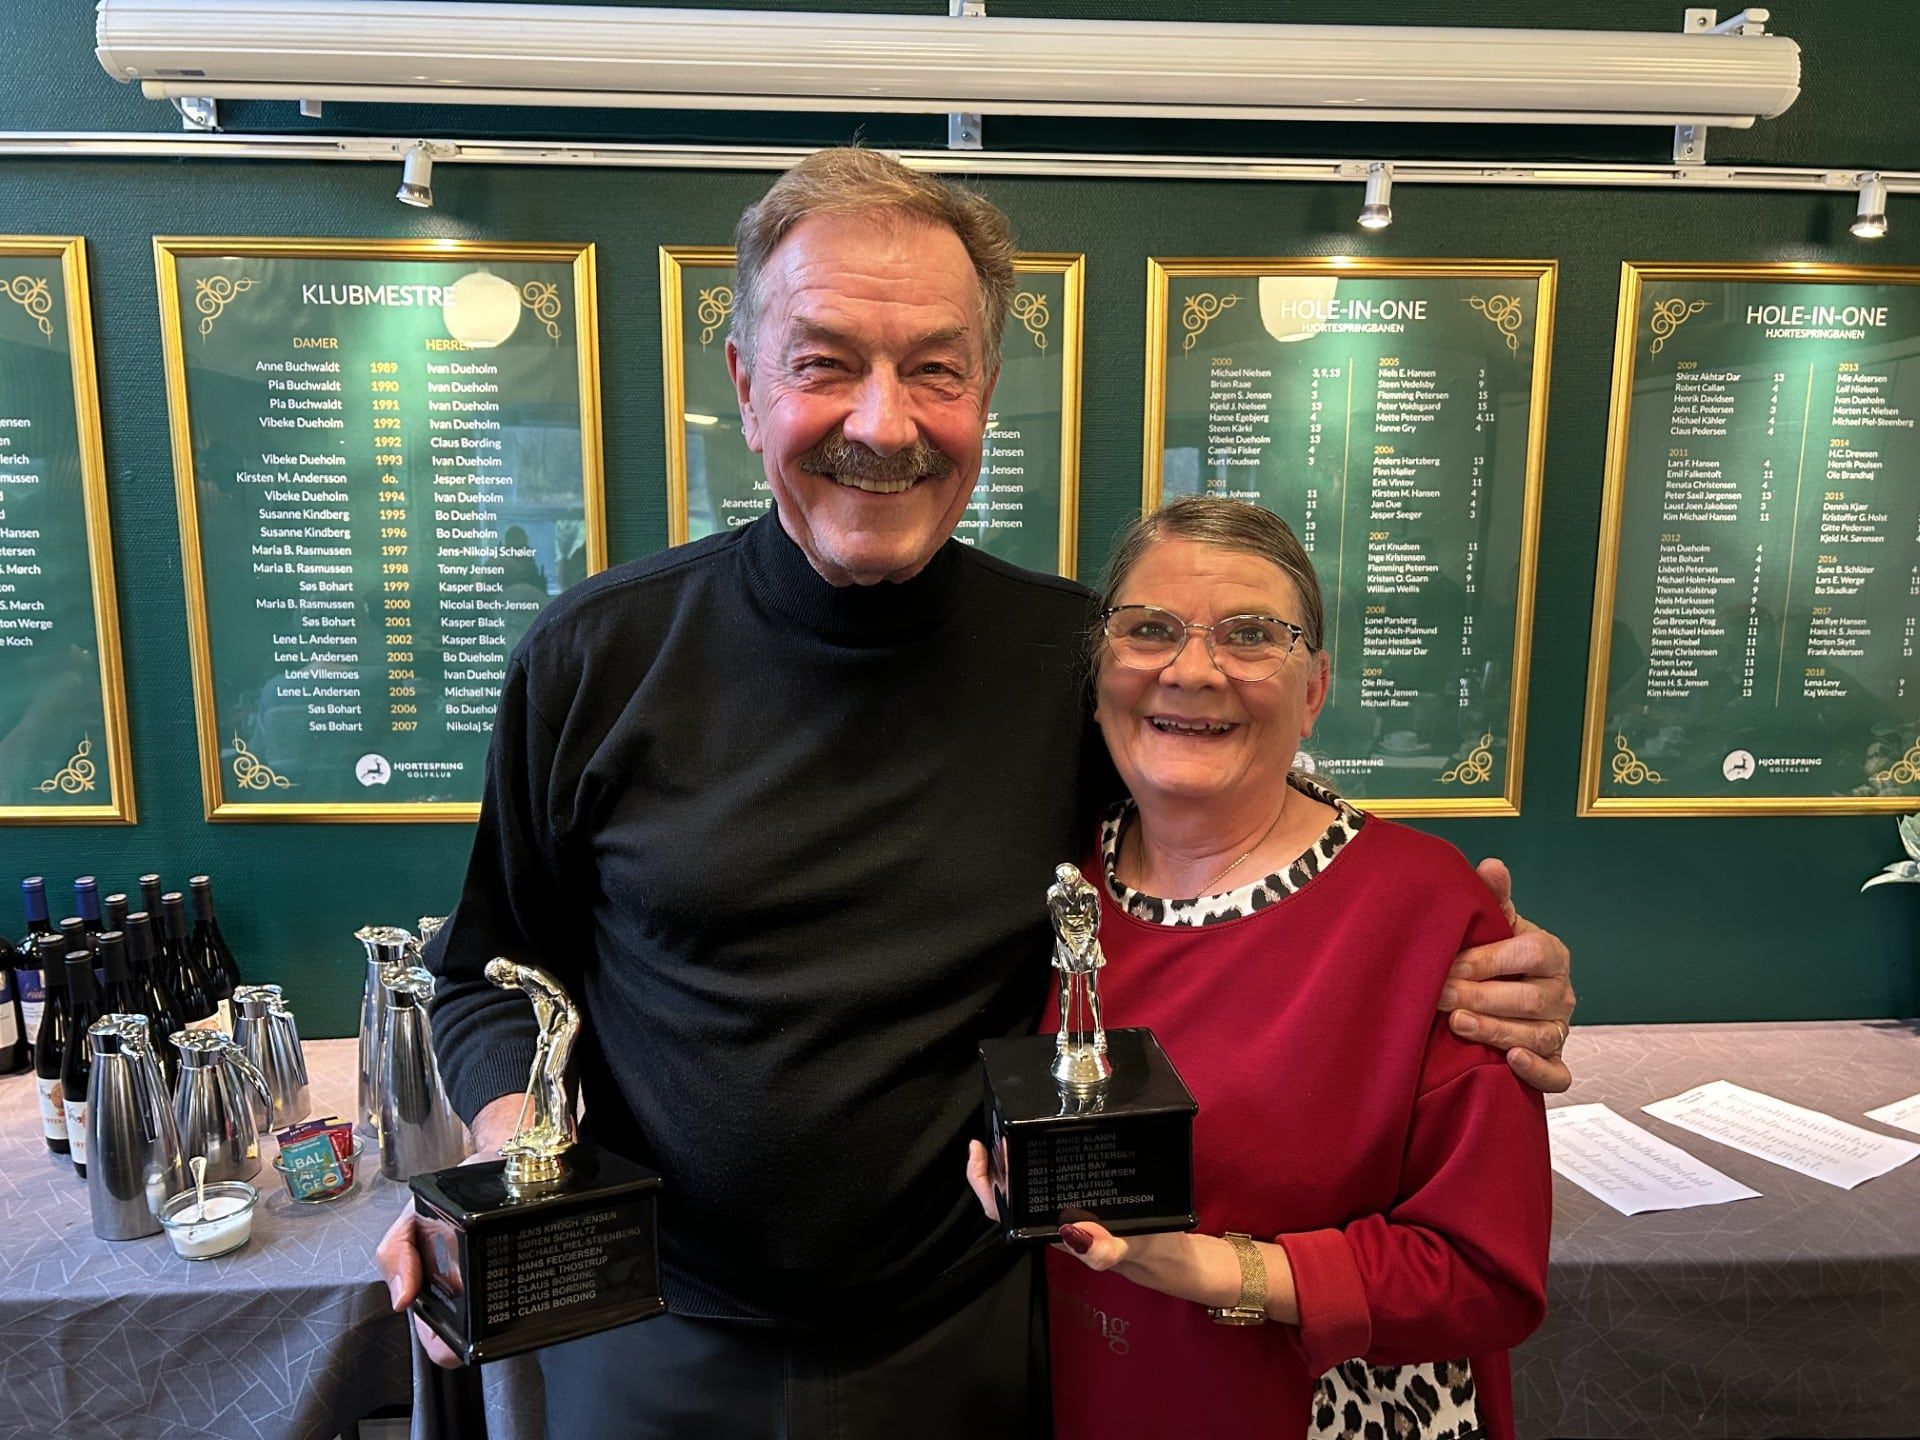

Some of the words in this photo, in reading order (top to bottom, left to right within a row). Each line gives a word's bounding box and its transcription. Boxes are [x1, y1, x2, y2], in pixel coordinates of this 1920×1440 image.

[294, 338, 338, 349] DAMER
[256, 361, 283, 371] Anne
[286, 362, 340, 372] Buchwaldt
[427, 363, 450, 374] Ivan
[451, 363, 497, 374] Dueholm
[269, 380, 284, 389] Pia
[287, 380, 342, 391] Buchwaldt
[260, 417, 294, 427] Vibeke
[297, 418, 344, 428] Dueholm
[374, 418, 400, 429] 1992
[430, 419, 452, 429] Ivan
[453, 419, 500, 429] Dueholm
[375, 437, 401, 447] 1992
[430, 437, 459, 448] Claus
[461, 438, 501, 450] Bording
[992, 447, 1024, 456] Jensen
[989, 465, 1023, 474] Jensen
[237, 472, 273, 482] Kirsten
[278, 472, 290, 482] M.
[293, 472, 347, 483] Andersson
[382, 474, 398, 484] do.
[434, 474, 466, 486] Jesper
[468, 474, 512, 484] Petersen
[989, 483, 1023, 492] Jensen
[722, 499, 763, 508] Jeanette
[989, 501, 1022, 510] Jensen
[260, 509, 301, 519] Susanne
[303, 509, 350, 522] Kindberg
[380, 510, 406, 520] 1995
[436, 510, 449, 520] Bo
[451, 510, 496, 520] Dueholm
[0, 528, 39, 538] Hansen
[252, 545, 282, 555] Maria
[284, 545, 294, 555] B.
[296, 545, 352, 555] Rasmussen
[383, 546, 407, 555] 1997
[438, 546, 498, 558] Jens-Nikolaj
[4, 564, 41, 574] Mørch
[438, 564, 468, 576] Tonny
[470, 565, 504, 574] Jensen
[319, 581, 353, 591] Bohart
[384, 582, 409, 591] 1999
[439, 582, 474, 593] Kasper
[476, 582, 503, 592] Black
[10, 601, 44, 610] Mørch
[476, 600, 539, 610] Bech-Jensen
[16, 619, 52, 630] Werge
[6, 636, 32, 646] Koch
[274, 634, 297, 644] Lene
[309, 634, 357, 644] Andersen
[311, 670, 359, 680] Villemoes
[389, 670, 414, 679] 2004
[445, 687, 485, 697] Michael
[392, 722, 417, 731] 2007
[394, 763, 463, 772] HJORTESPRING
[295, 1153, 324, 1169] BAL
[1057, 1192, 1079, 1201] ELSE
[1057, 1199, 1098, 1210] ANNETTE
[1100, 1195, 1154, 1206] PETERSSON
[517, 1280, 549, 1294] CLAUS
[552, 1270, 595, 1286] BORDING
[517, 1291, 550, 1305] CLAUS
[552, 1280, 596, 1296] BORDING
[488, 1312, 510, 1324] 2025
[518, 1302, 550, 1316] CLAUS
[552, 1290, 596, 1308] BORDING
